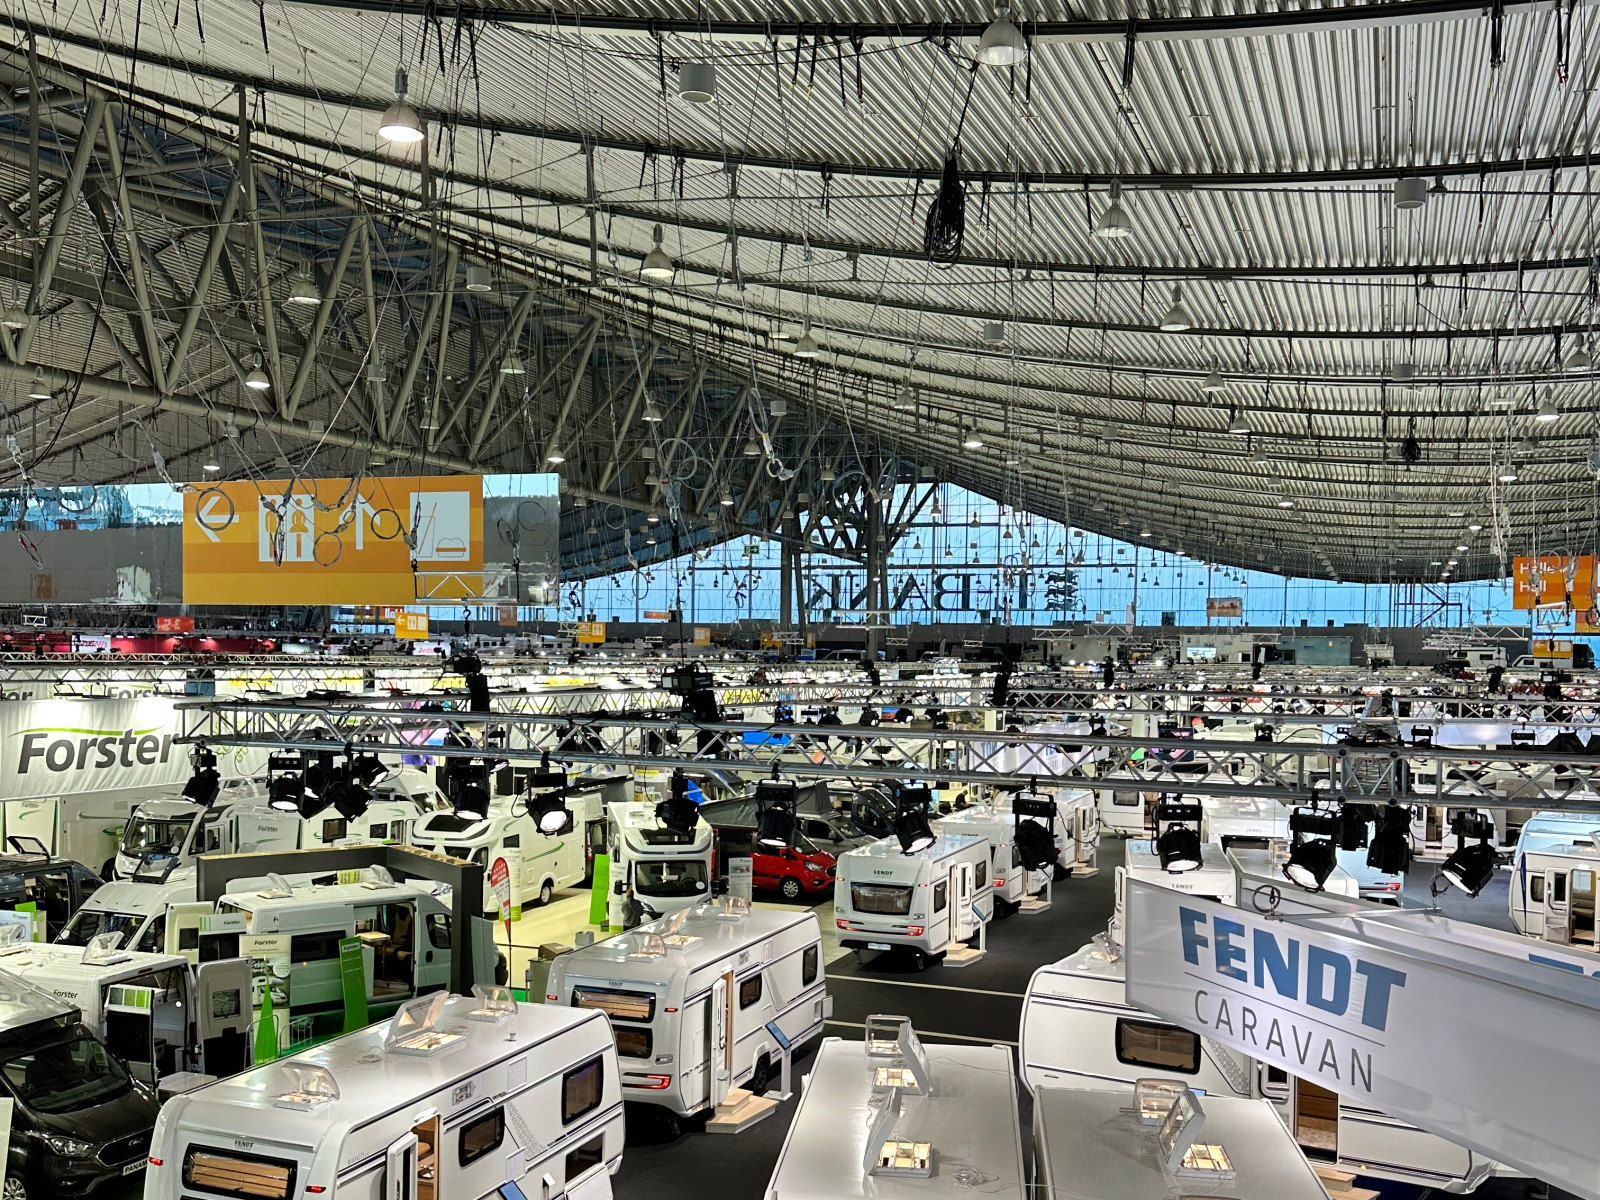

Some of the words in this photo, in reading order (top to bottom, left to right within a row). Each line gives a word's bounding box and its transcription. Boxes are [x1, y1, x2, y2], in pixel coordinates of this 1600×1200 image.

[17, 729, 180, 774] Forster
[1180, 906, 1406, 1031] FENDT
[53, 989, 79, 999] Forster
[1196, 990, 1373, 1092] CARAVAN
[234, 1139, 254, 1148] FENDT
